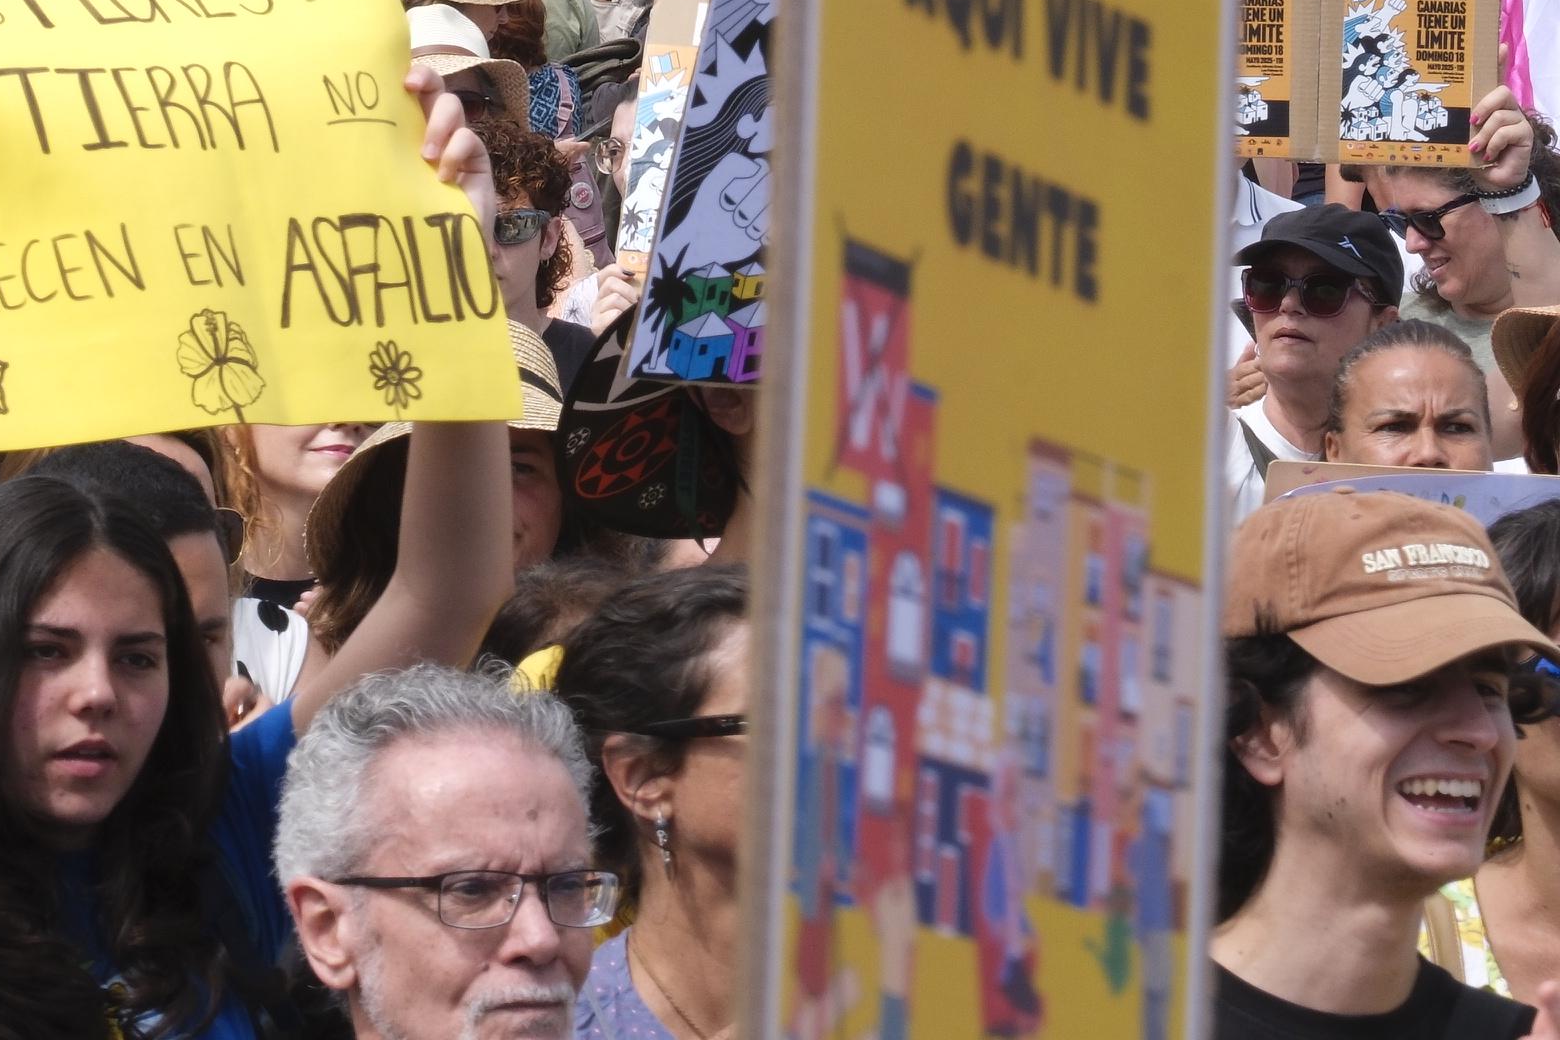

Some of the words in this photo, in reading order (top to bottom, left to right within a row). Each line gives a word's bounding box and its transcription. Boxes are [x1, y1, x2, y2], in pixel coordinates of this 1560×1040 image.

[1269, 7, 1284, 22] UN
[1417, 0, 1466, 14] CANARIAS
[1417, 13, 1448, 29] TIENE
[1451, 15, 1466, 30] UN
[1416, 28, 1465, 50] LÍMITE
[1240, 44, 1273, 55] OMINGO
[1275, 45, 1284, 55] 18
[1416, 50, 1454, 63] DOMINGO
[1455, 52, 1465, 63] 18
[322, 72, 381, 115] NO
[947, 139, 1100, 306] GENTE
[173, 223, 247, 288] EN
[280, 212, 499, 330] ASFALTO
[1362, 548, 1402, 574] SAN
[1402, 543, 1491, 569] FRANCISCO
